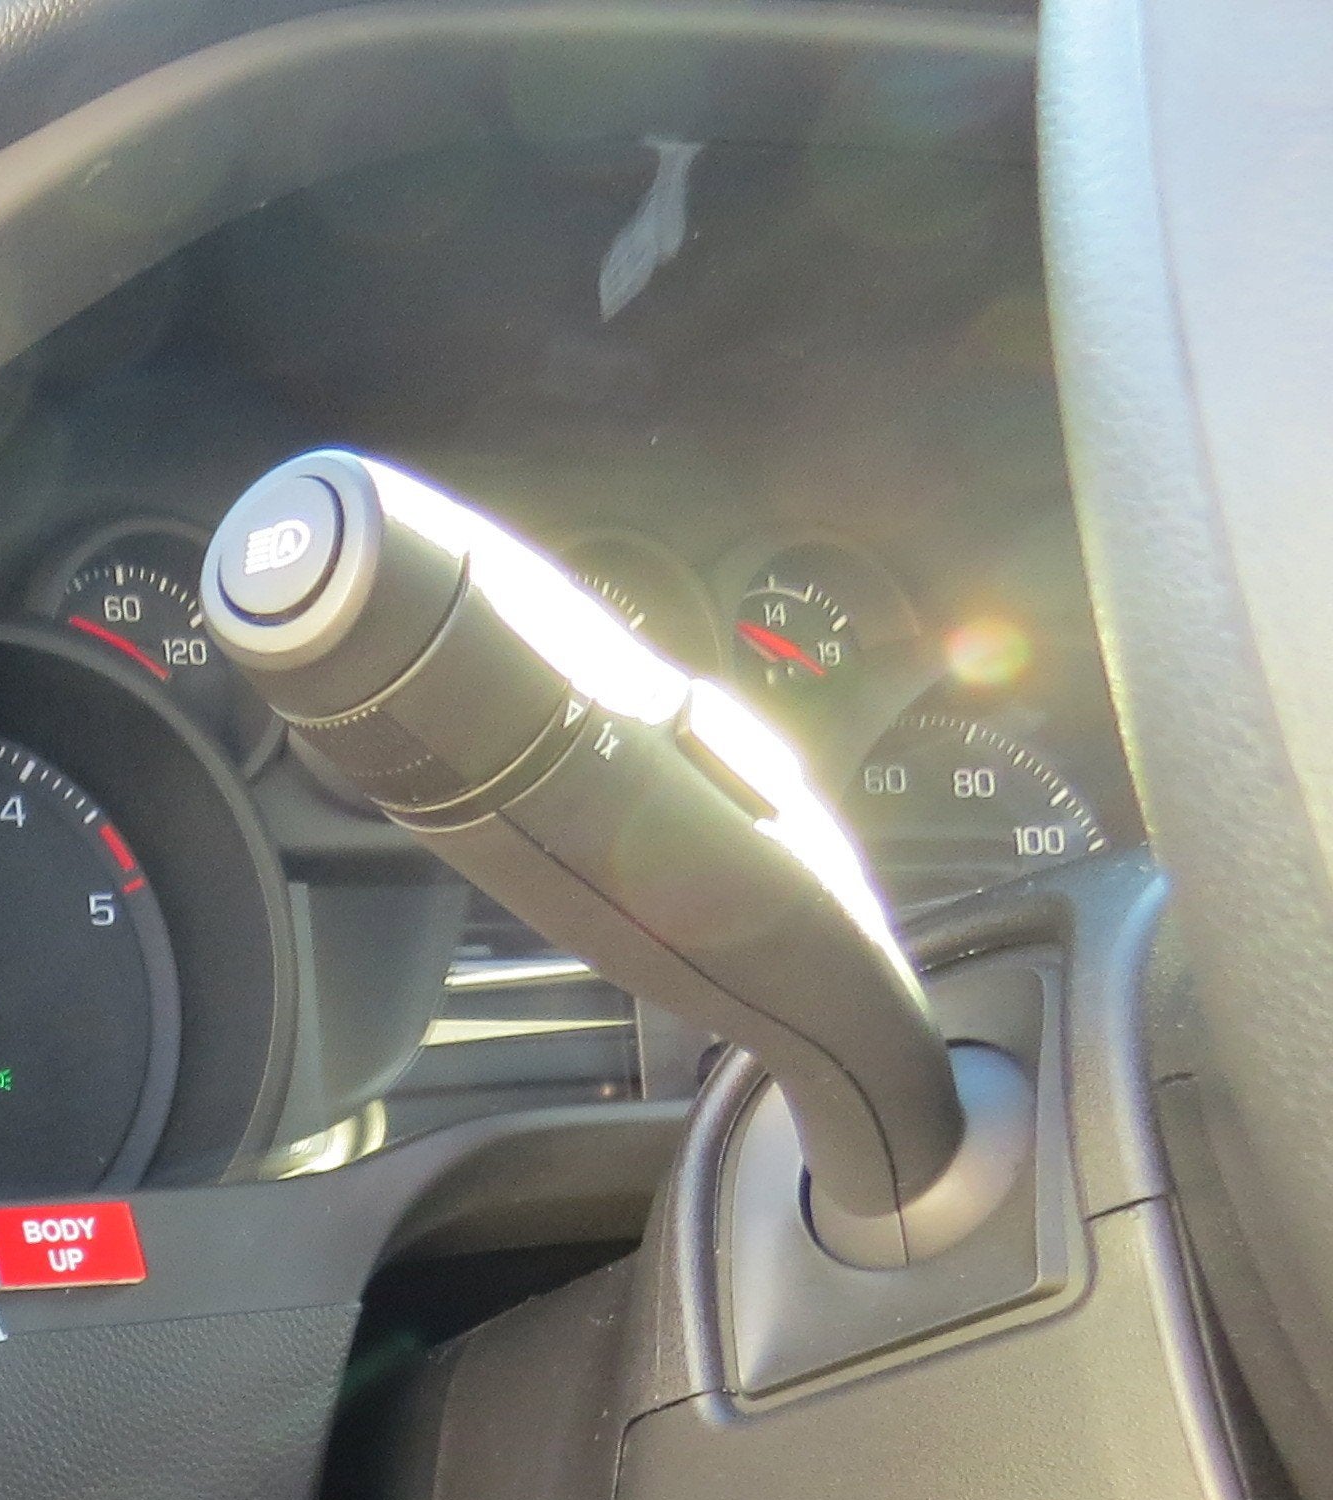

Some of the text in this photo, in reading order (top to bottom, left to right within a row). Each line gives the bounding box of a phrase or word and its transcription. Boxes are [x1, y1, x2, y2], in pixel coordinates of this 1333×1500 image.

[104, 595, 141, 621] 60
[764, 602, 786, 627] 14
[162, 639, 207, 665] 120
[817, 641, 841, 666] 19
[864, 766, 907, 794] 60
[953, 769, 996, 797] 80
[0, 796, 26, 828] 4
[1015, 826, 1065, 855] 100
[89, 894, 115, 926] 5
[22, 1217, 95, 1244] BODY
[47, 1248, 85, 1272] UP
